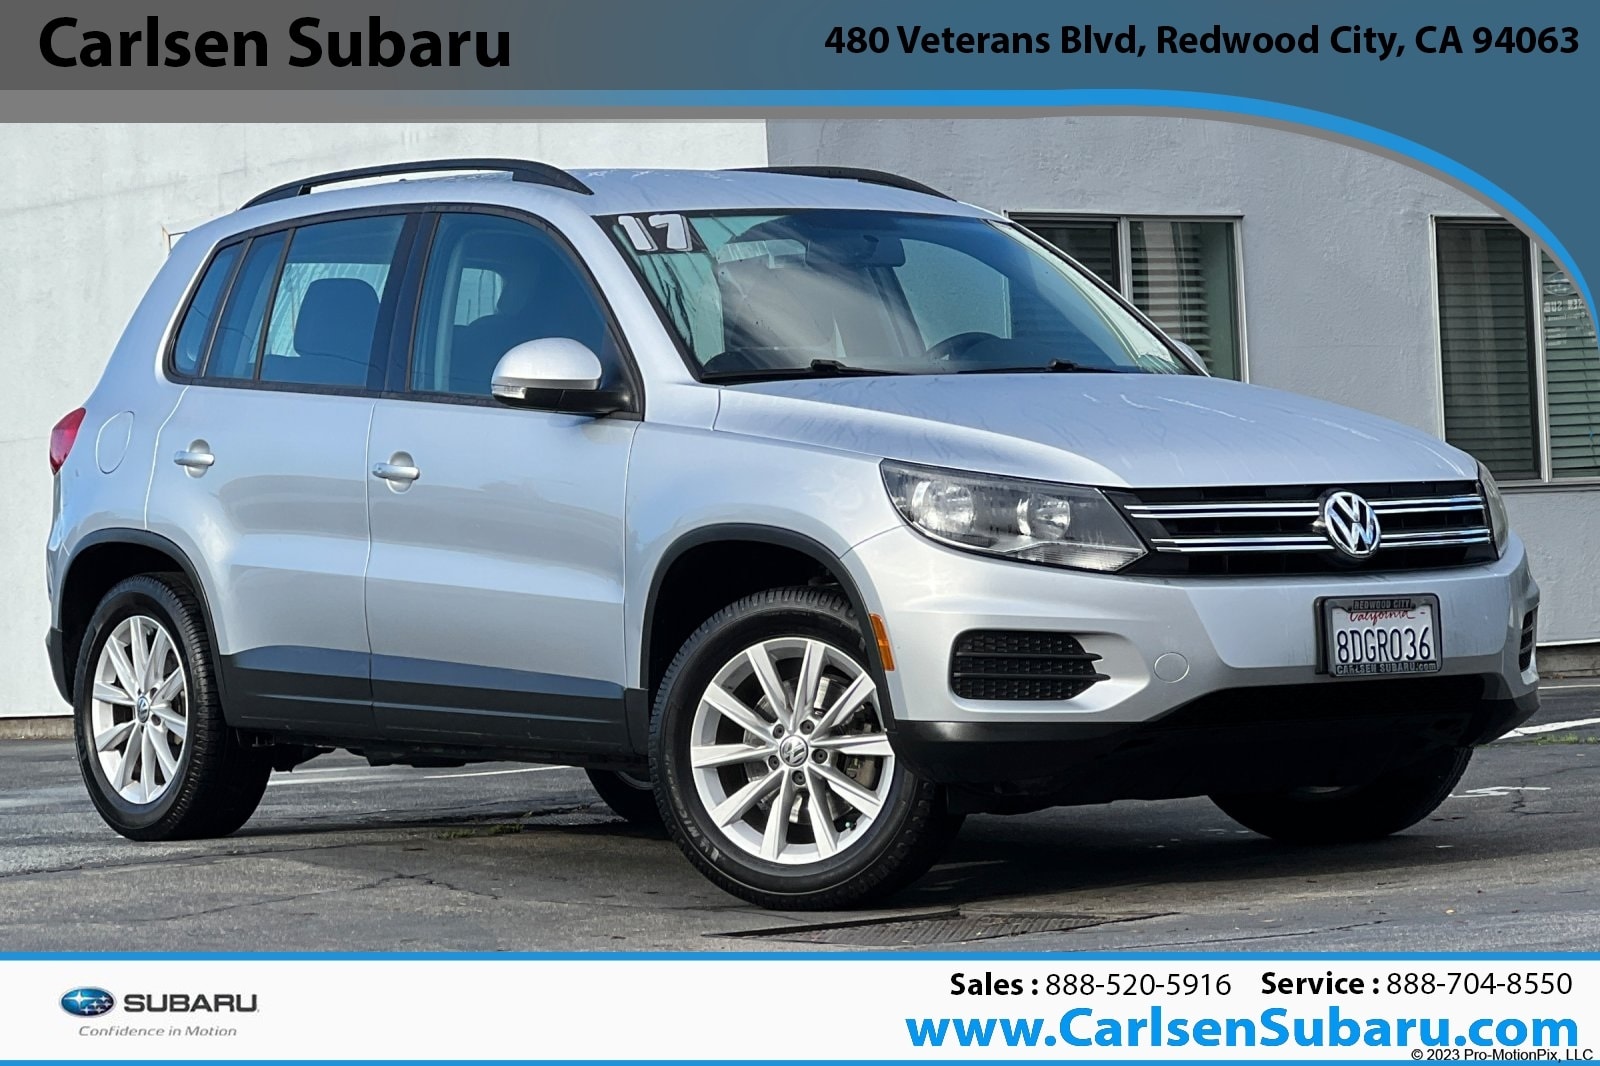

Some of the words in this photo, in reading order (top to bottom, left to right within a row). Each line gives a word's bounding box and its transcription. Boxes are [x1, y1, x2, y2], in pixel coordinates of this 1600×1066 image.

[618, 214, 692, 252] 17
[1354, 600, 1391, 610] REDWOOD
[1393, 599, 1411, 609] CITY
[1336, 626, 1431, 664] 8DGR036
[1336, 664, 1377, 674] CARLSEN
